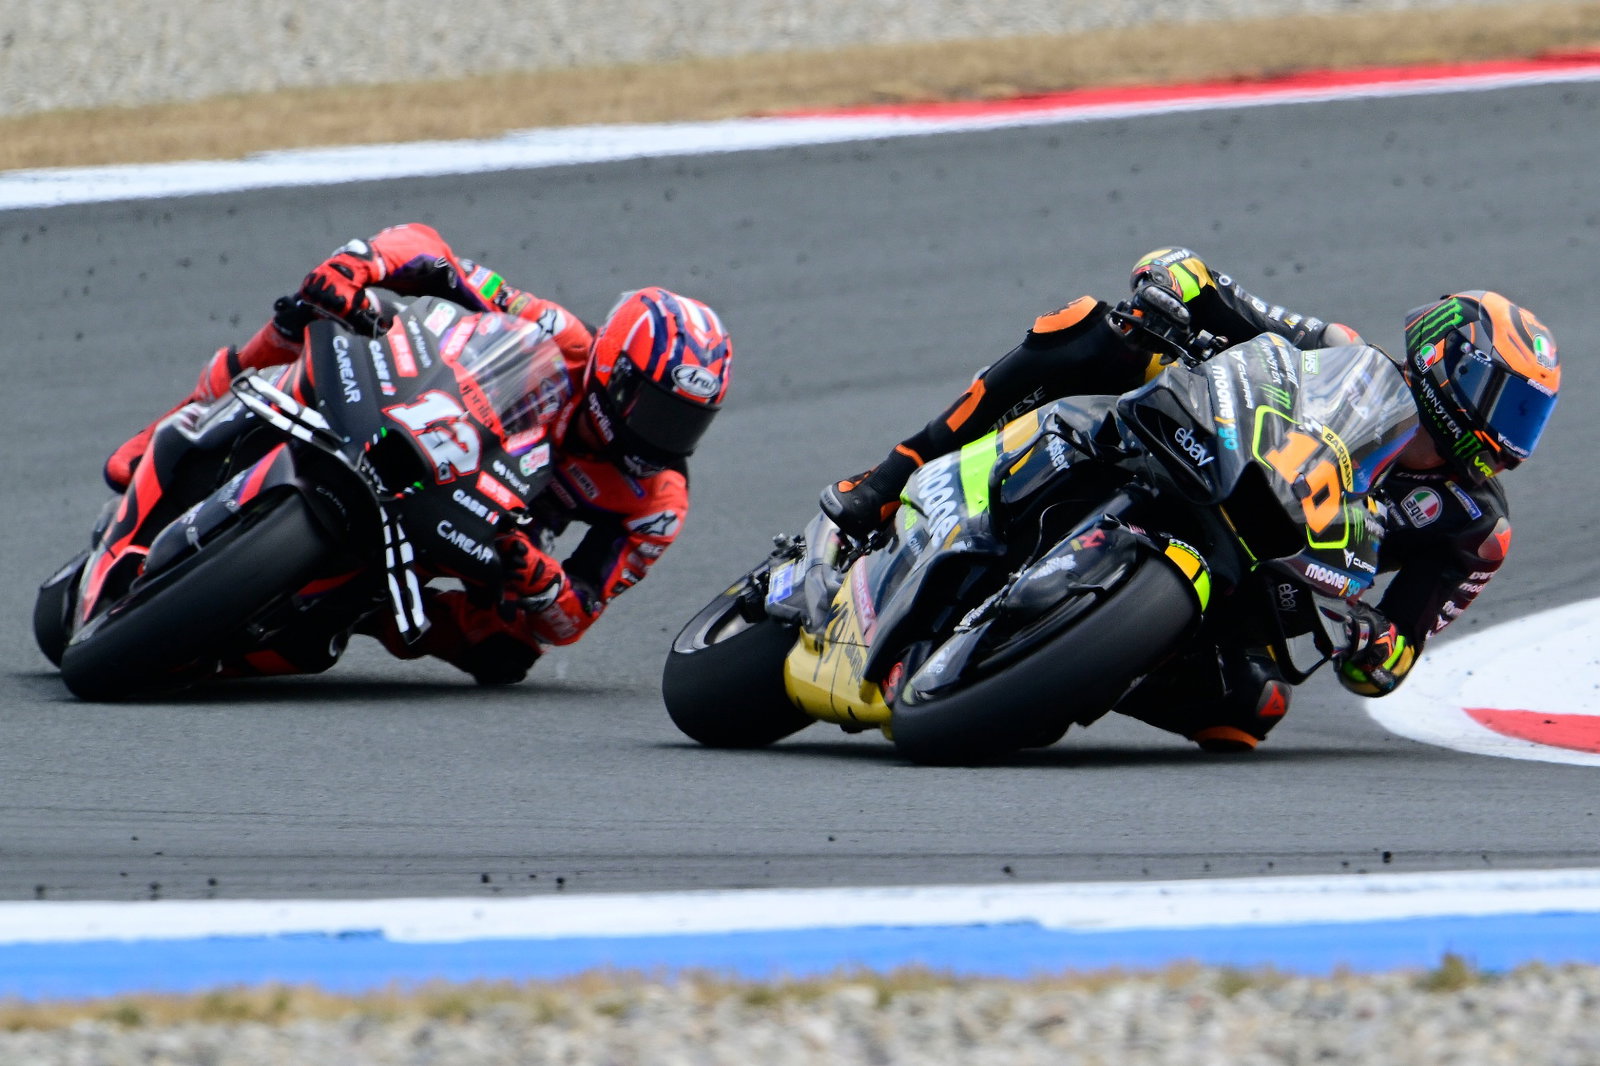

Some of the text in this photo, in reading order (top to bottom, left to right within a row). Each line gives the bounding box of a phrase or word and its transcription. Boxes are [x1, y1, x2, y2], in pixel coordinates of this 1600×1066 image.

[673, 368, 716, 390] Arai
[380, 389, 482, 485] 12
[1174, 427, 1215, 467] ebay
[1405, 499, 1428, 521] agv
